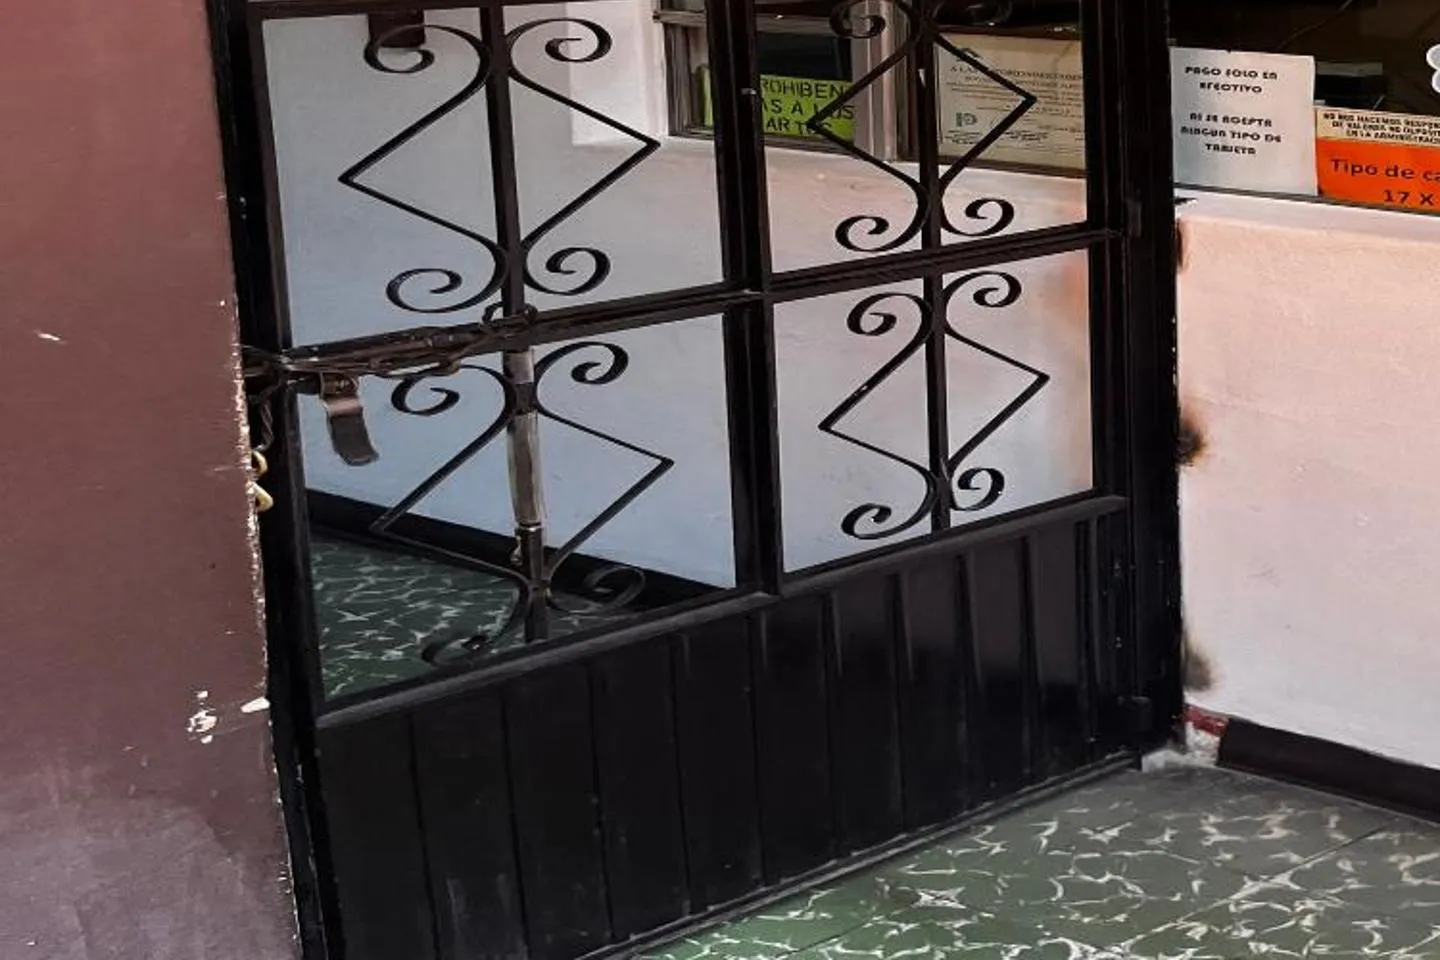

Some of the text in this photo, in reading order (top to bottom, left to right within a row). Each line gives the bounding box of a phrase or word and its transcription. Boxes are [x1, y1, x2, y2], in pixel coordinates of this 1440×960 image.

[1330, 159, 1378, 177] Tipo
[1385, 164, 1416, 179] de
[1384, 189, 1411, 204] 17
[1420, 193, 1434, 207] X
